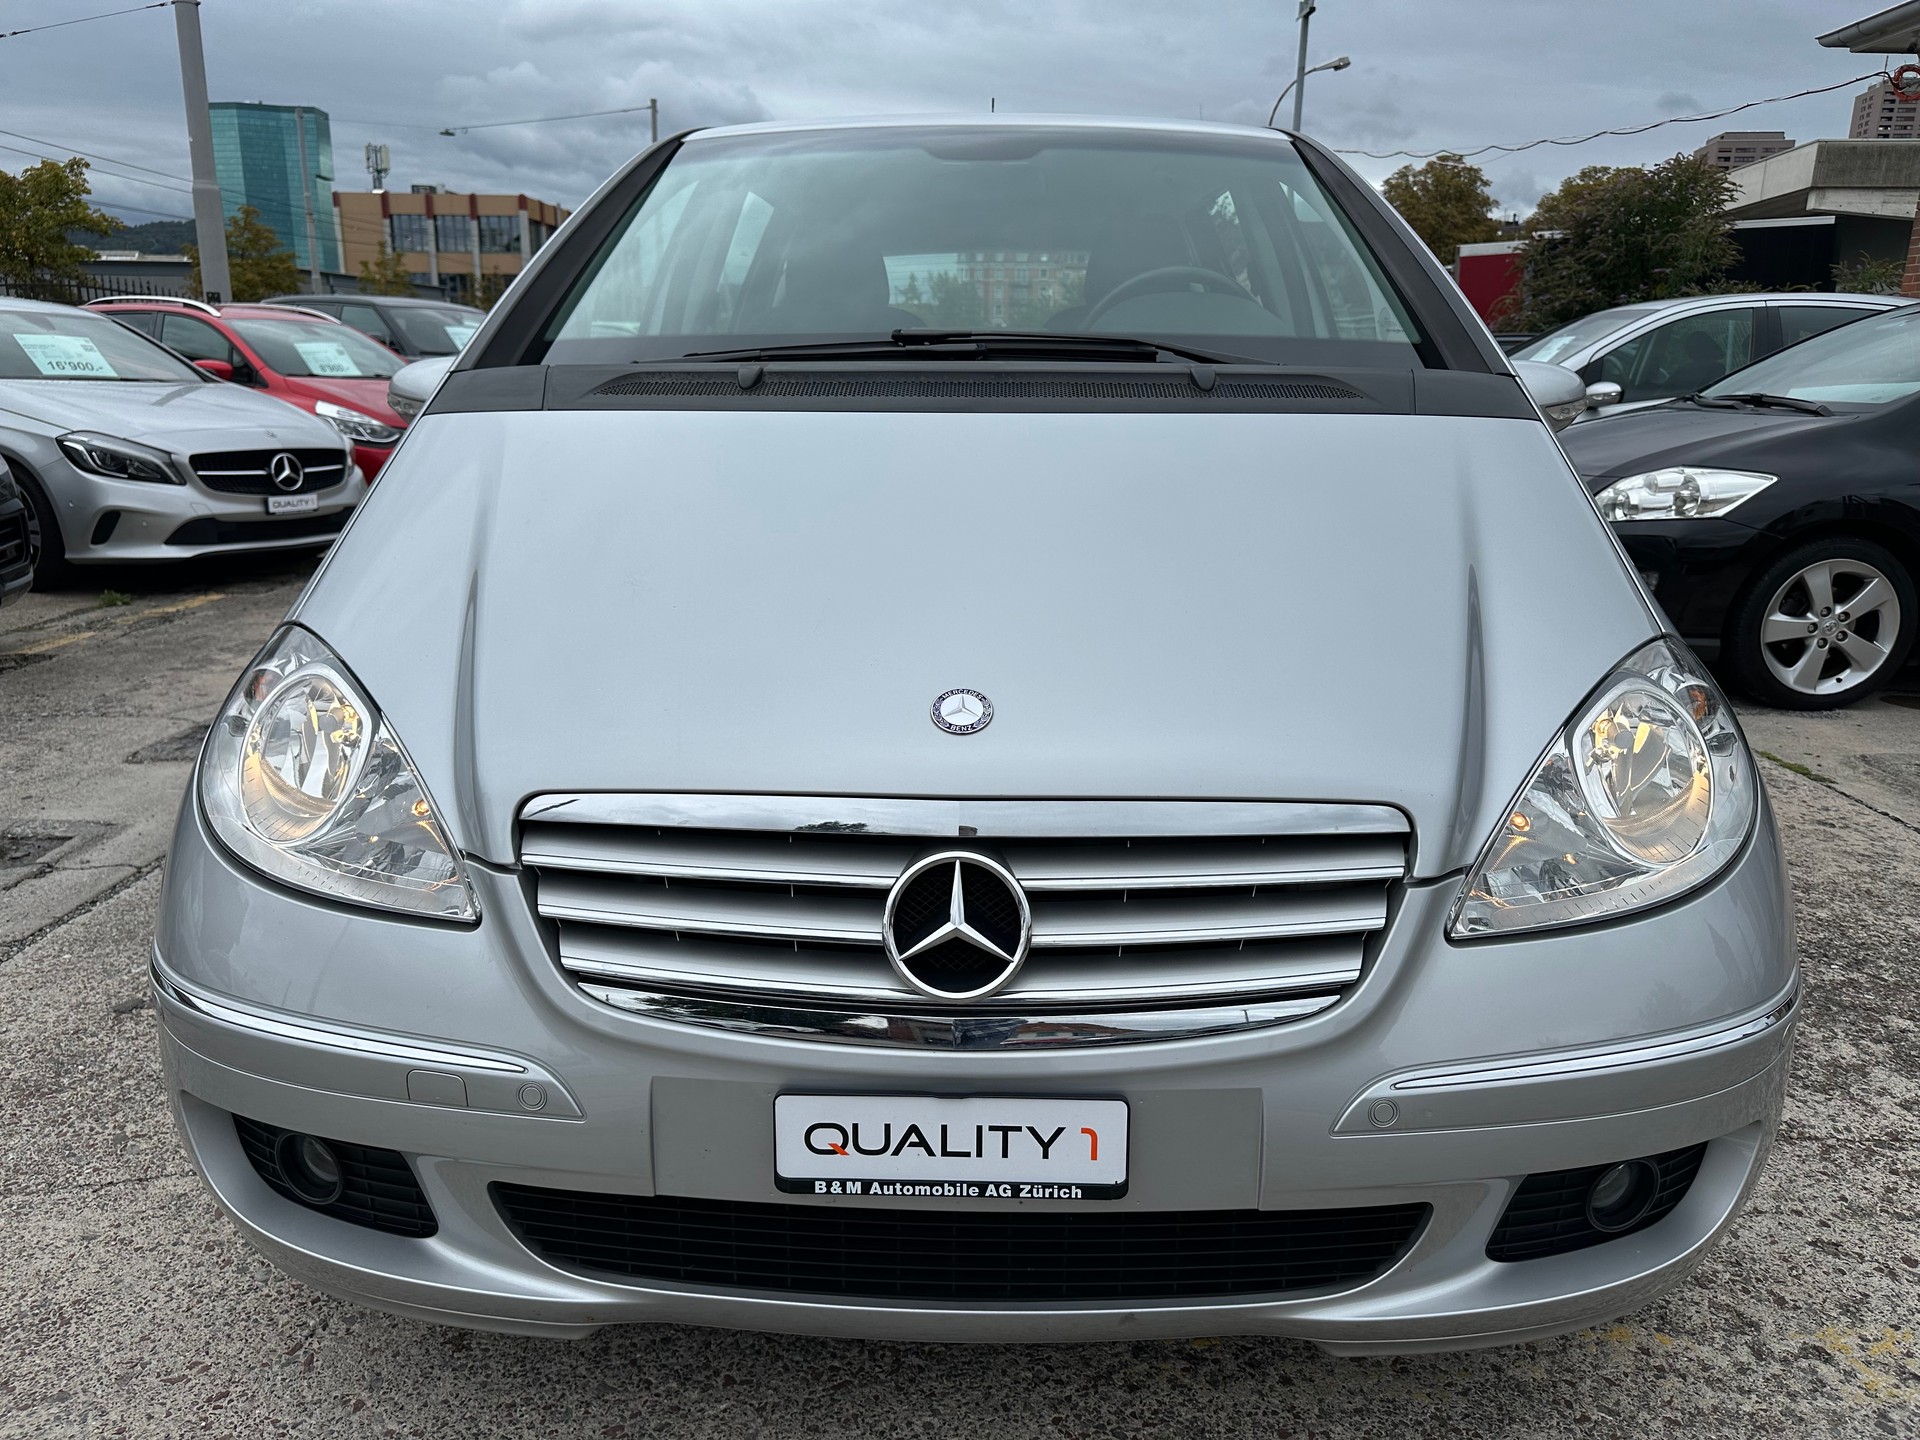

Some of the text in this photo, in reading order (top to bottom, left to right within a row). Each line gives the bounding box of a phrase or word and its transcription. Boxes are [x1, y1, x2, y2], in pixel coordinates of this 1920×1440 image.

[942, 689, 984, 700] MERCEDES
[804, 1122, 1099, 1161] QUALITY 1
[869, 1181, 980, 1197] Automobile
[984, 1183, 1013, 1198] AG
[1019, 1184, 1083, 1199] Zürich
